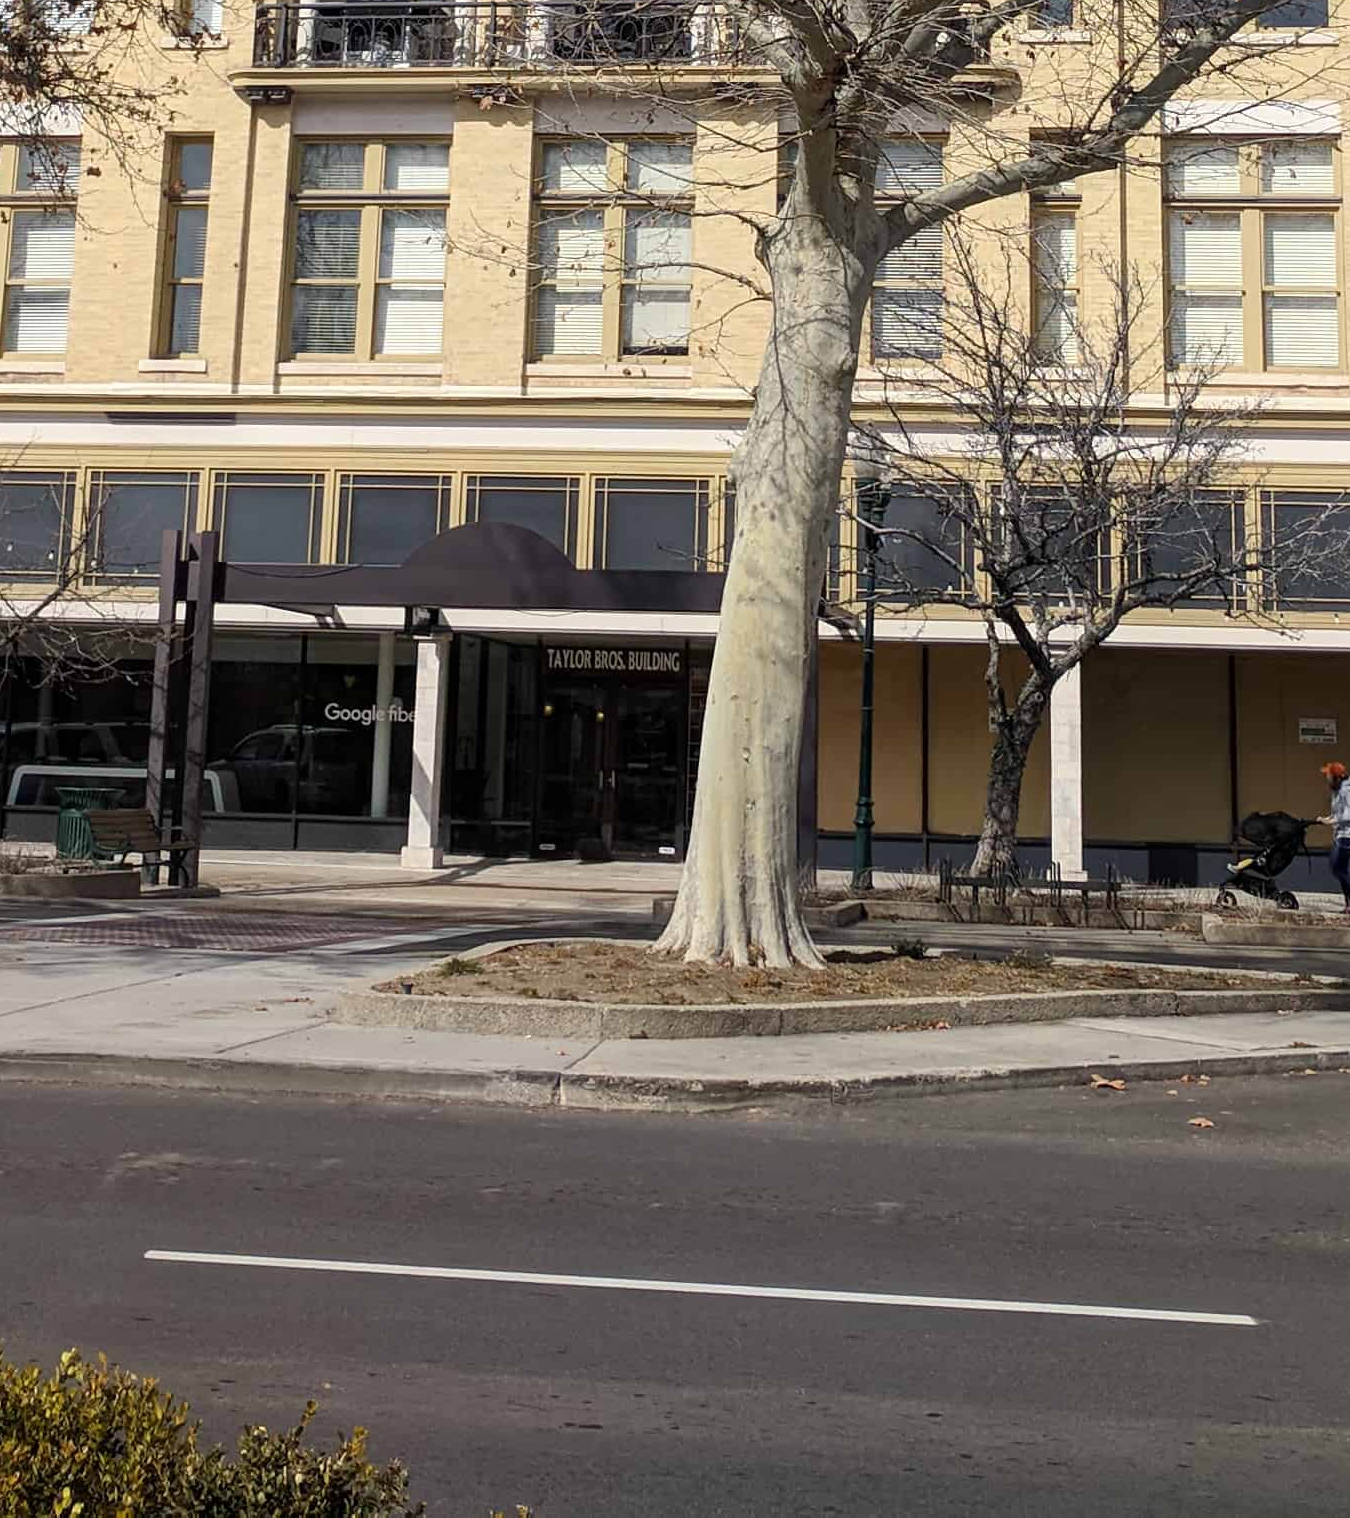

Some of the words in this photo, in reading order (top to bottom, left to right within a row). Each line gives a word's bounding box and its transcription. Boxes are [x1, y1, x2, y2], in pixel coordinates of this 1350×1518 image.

[547, 649, 592, 669] TAYLOR
[594, 650, 626, 670] BROS.
[628, 651, 680, 672] BUILDING
[324, 702, 385, 726] Google
[388, 703, 416, 723] fibe
